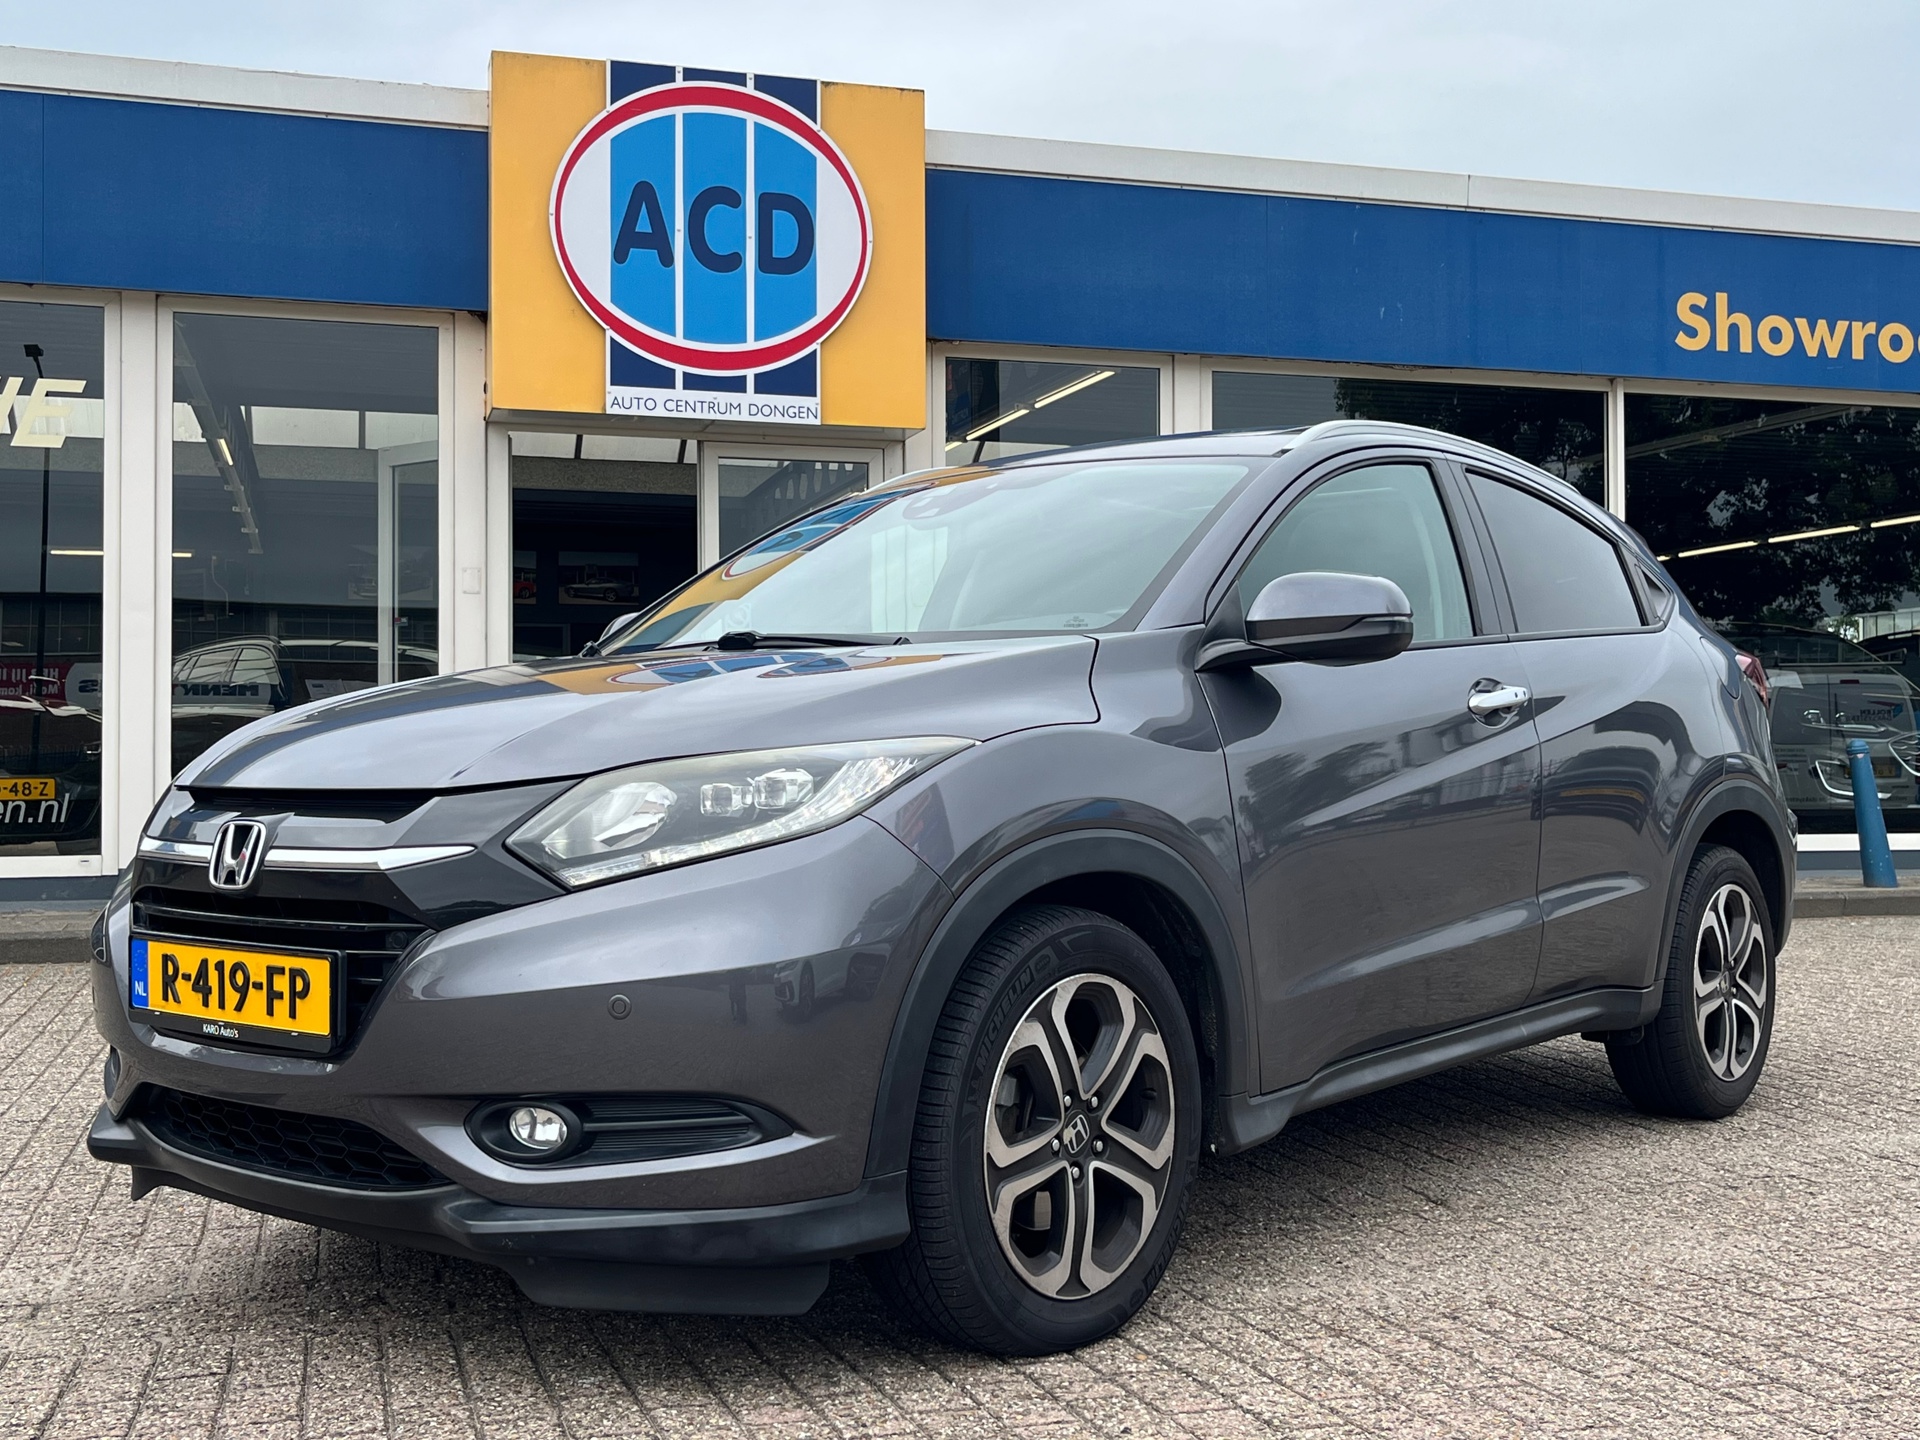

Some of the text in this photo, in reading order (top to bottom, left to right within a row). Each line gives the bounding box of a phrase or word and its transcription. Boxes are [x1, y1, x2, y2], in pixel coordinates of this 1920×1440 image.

[613, 180, 815, 275] ACD
[1675, 292, 1920, 364] Showro
[610, 396, 819, 420] AUTO CENTRUM DONGEN
[0, 781, 49, 797] -48-Z
[134, 980, 147, 997] NL
[161, 953, 311, 1020] R-419-FP
[202, 1023, 219, 1036] KARO
[975, 966, 1035, 1072] MICHELIN
